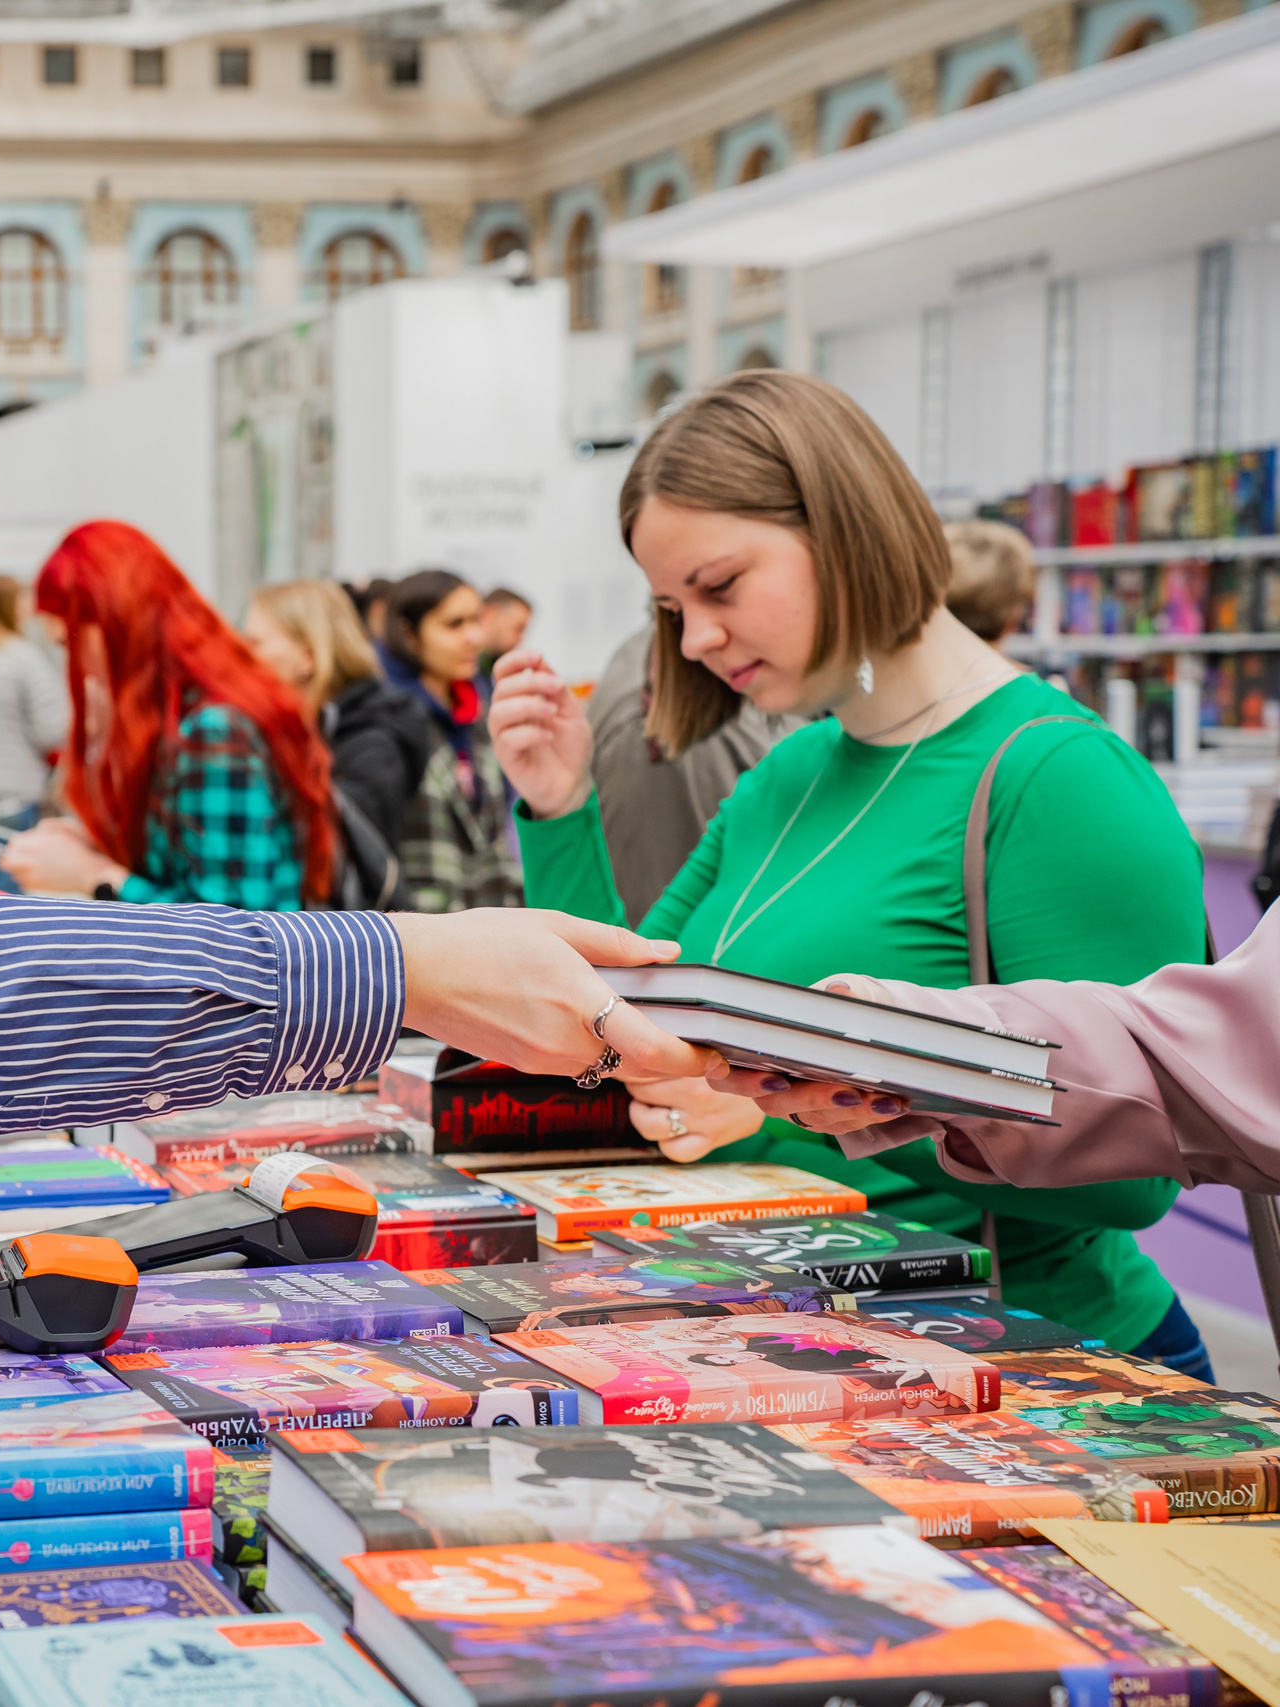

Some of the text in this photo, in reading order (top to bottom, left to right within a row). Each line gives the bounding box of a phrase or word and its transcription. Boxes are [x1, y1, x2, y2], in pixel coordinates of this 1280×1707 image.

[657, 1213, 696, 1227] КНИГ
[901, 1257, 948, 1270] ХАНИПАЕВ
[814, 1262, 886, 1287] ЛУНА
[909, 1269, 941, 1279] ИСЛАМ
[747, 1386, 828, 1421] УБИЙСТВО
[854, 1388, 939, 1403] НЭНСИ УОРРЕН
[276, 1411, 373, 1432] «ПЕРЕПЛЕТ
[399, 1415, 465, 1429] СО ДОНВОН
[852, 1421, 1041, 1488] ВАМПИРСКИЙ
[45, 1475, 155, 1495] АЛИ ХЕЙЗЕЛВУД
[998, 1518, 1030, 1530] РРЕН
[42, 1539, 151, 1558] АЛИ ХЕЙЗЕЛВУД
